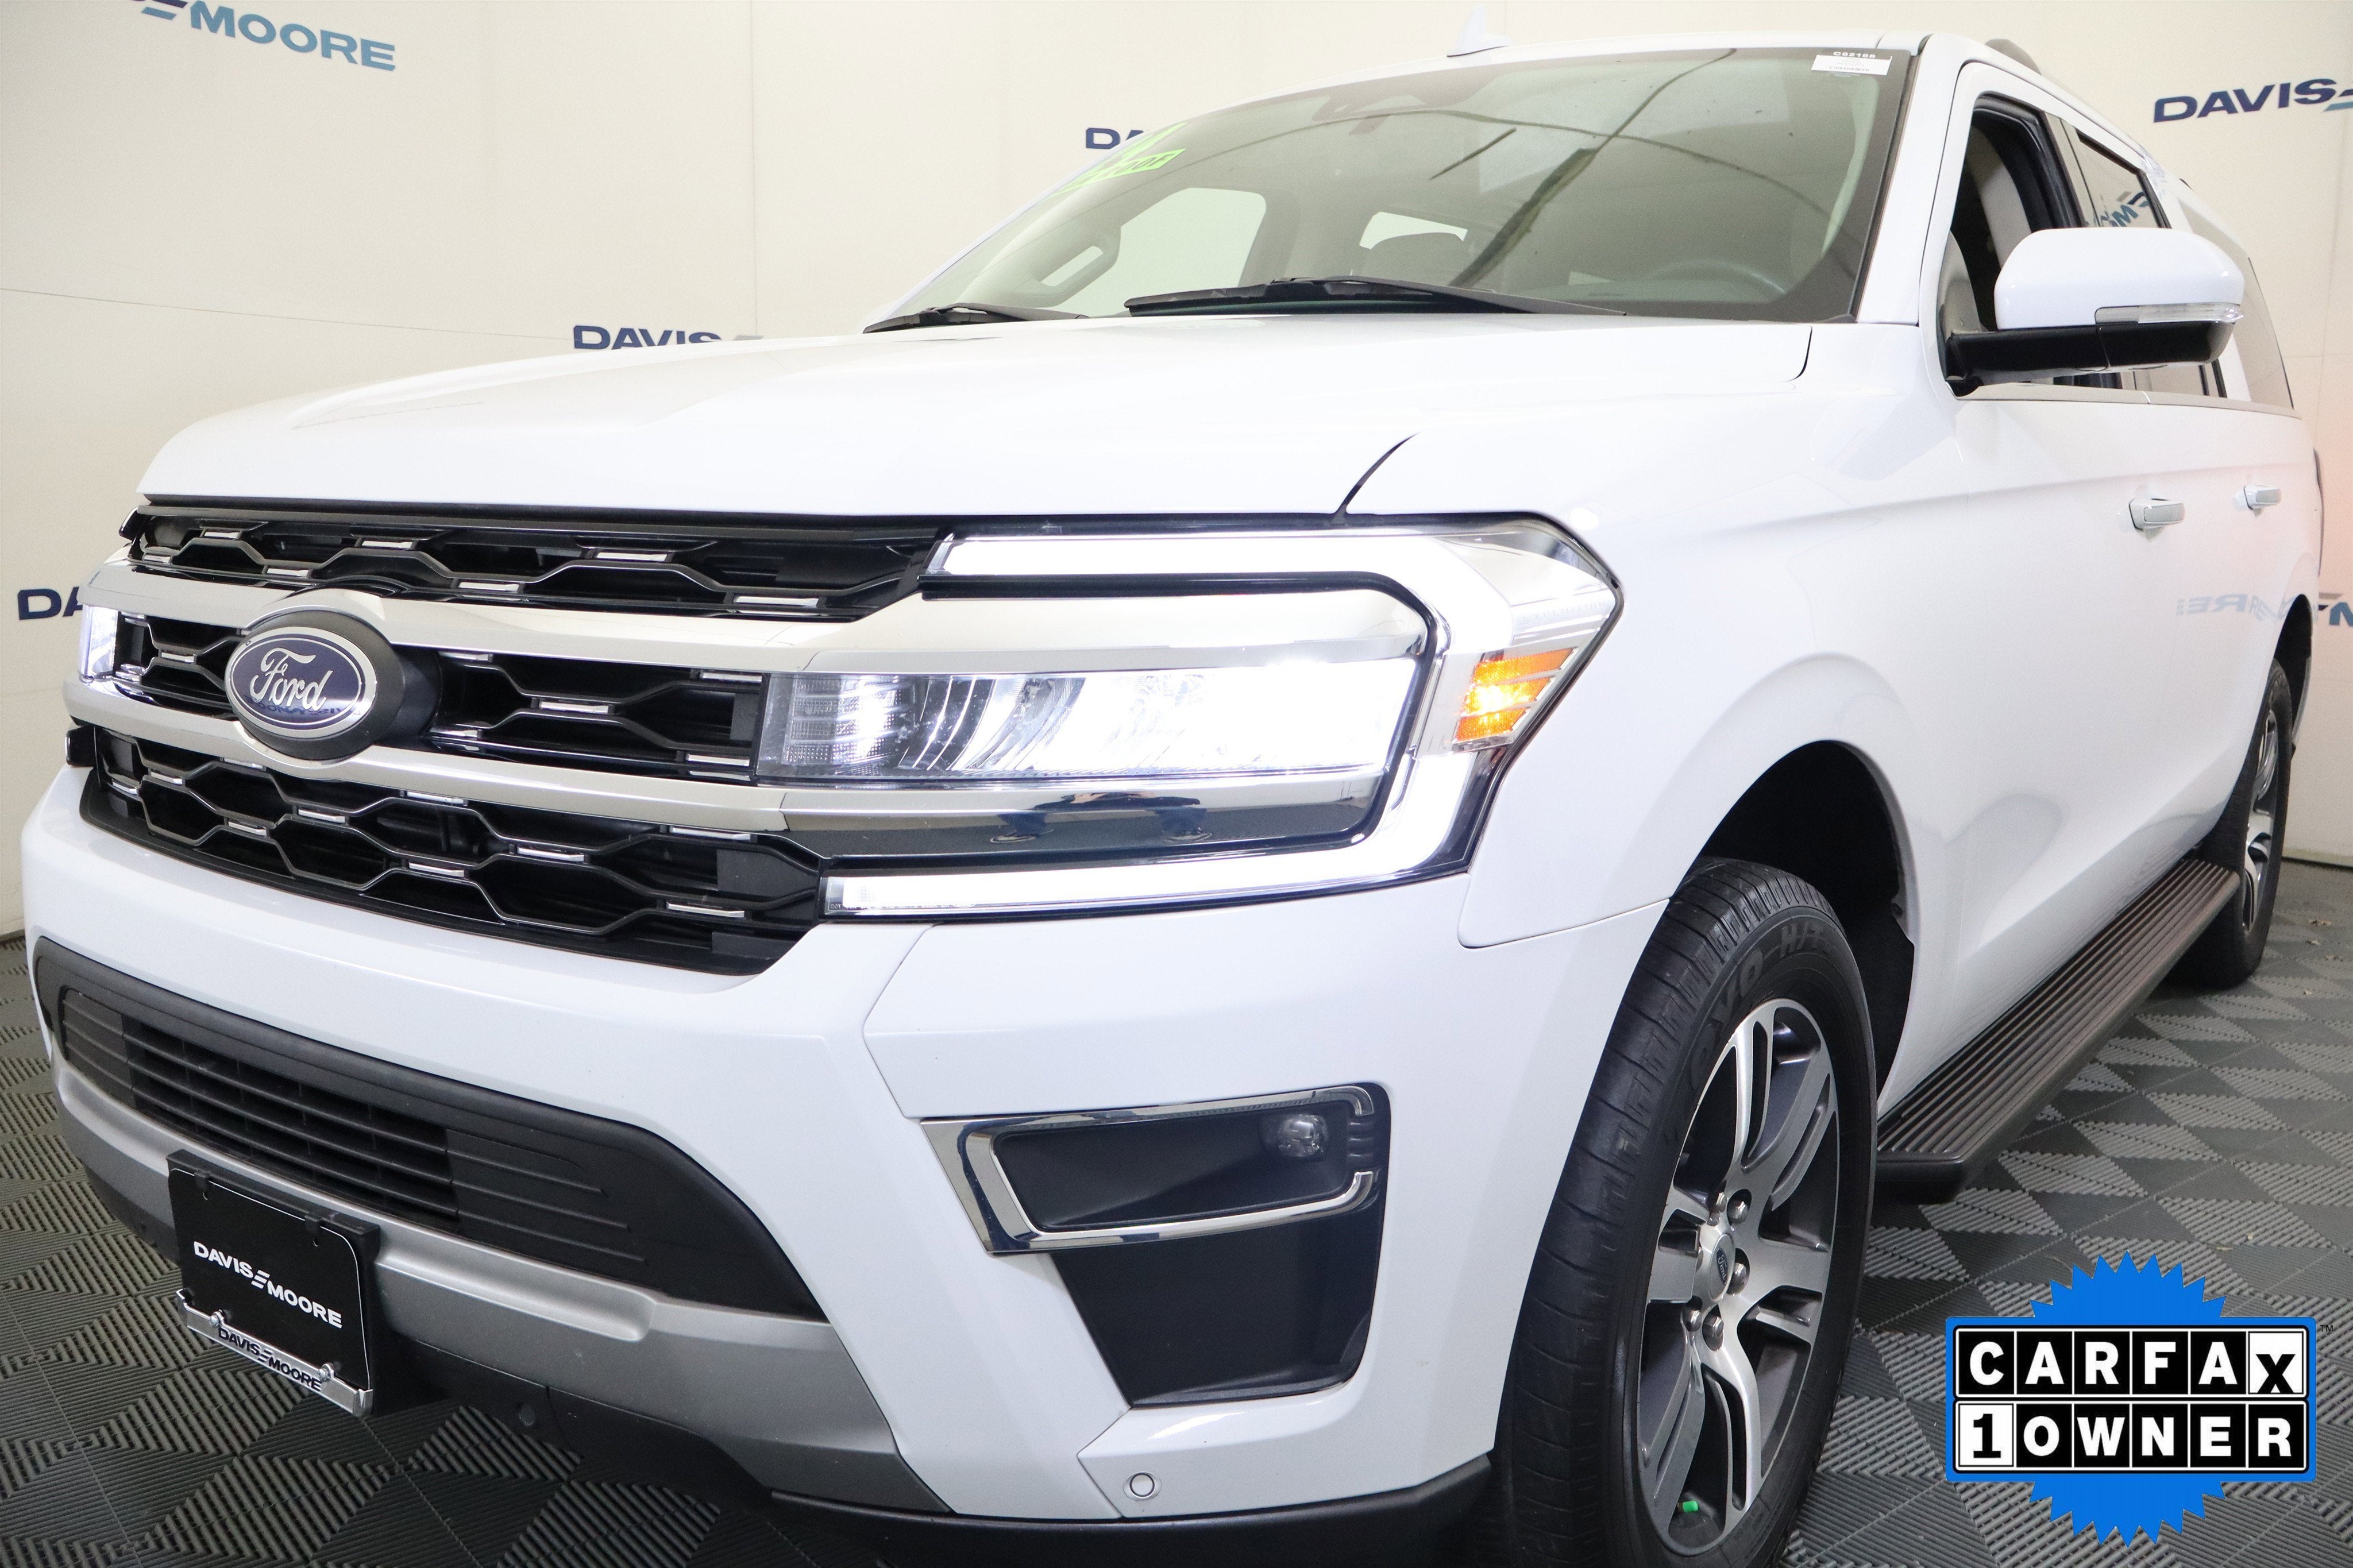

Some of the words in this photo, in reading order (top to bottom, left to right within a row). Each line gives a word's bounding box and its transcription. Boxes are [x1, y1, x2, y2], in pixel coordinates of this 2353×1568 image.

[190, 0, 396, 71] MOORE
[2153, 78, 2337, 123] DAVIS
[250, 647, 334, 711] Ford
[194, 1241, 253, 1279] DAVIS
[267, 1281, 343, 1328] MOORE
[218, 1327, 260, 1355] DAVIS
[269, 1357, 322, 1389] MOORE
